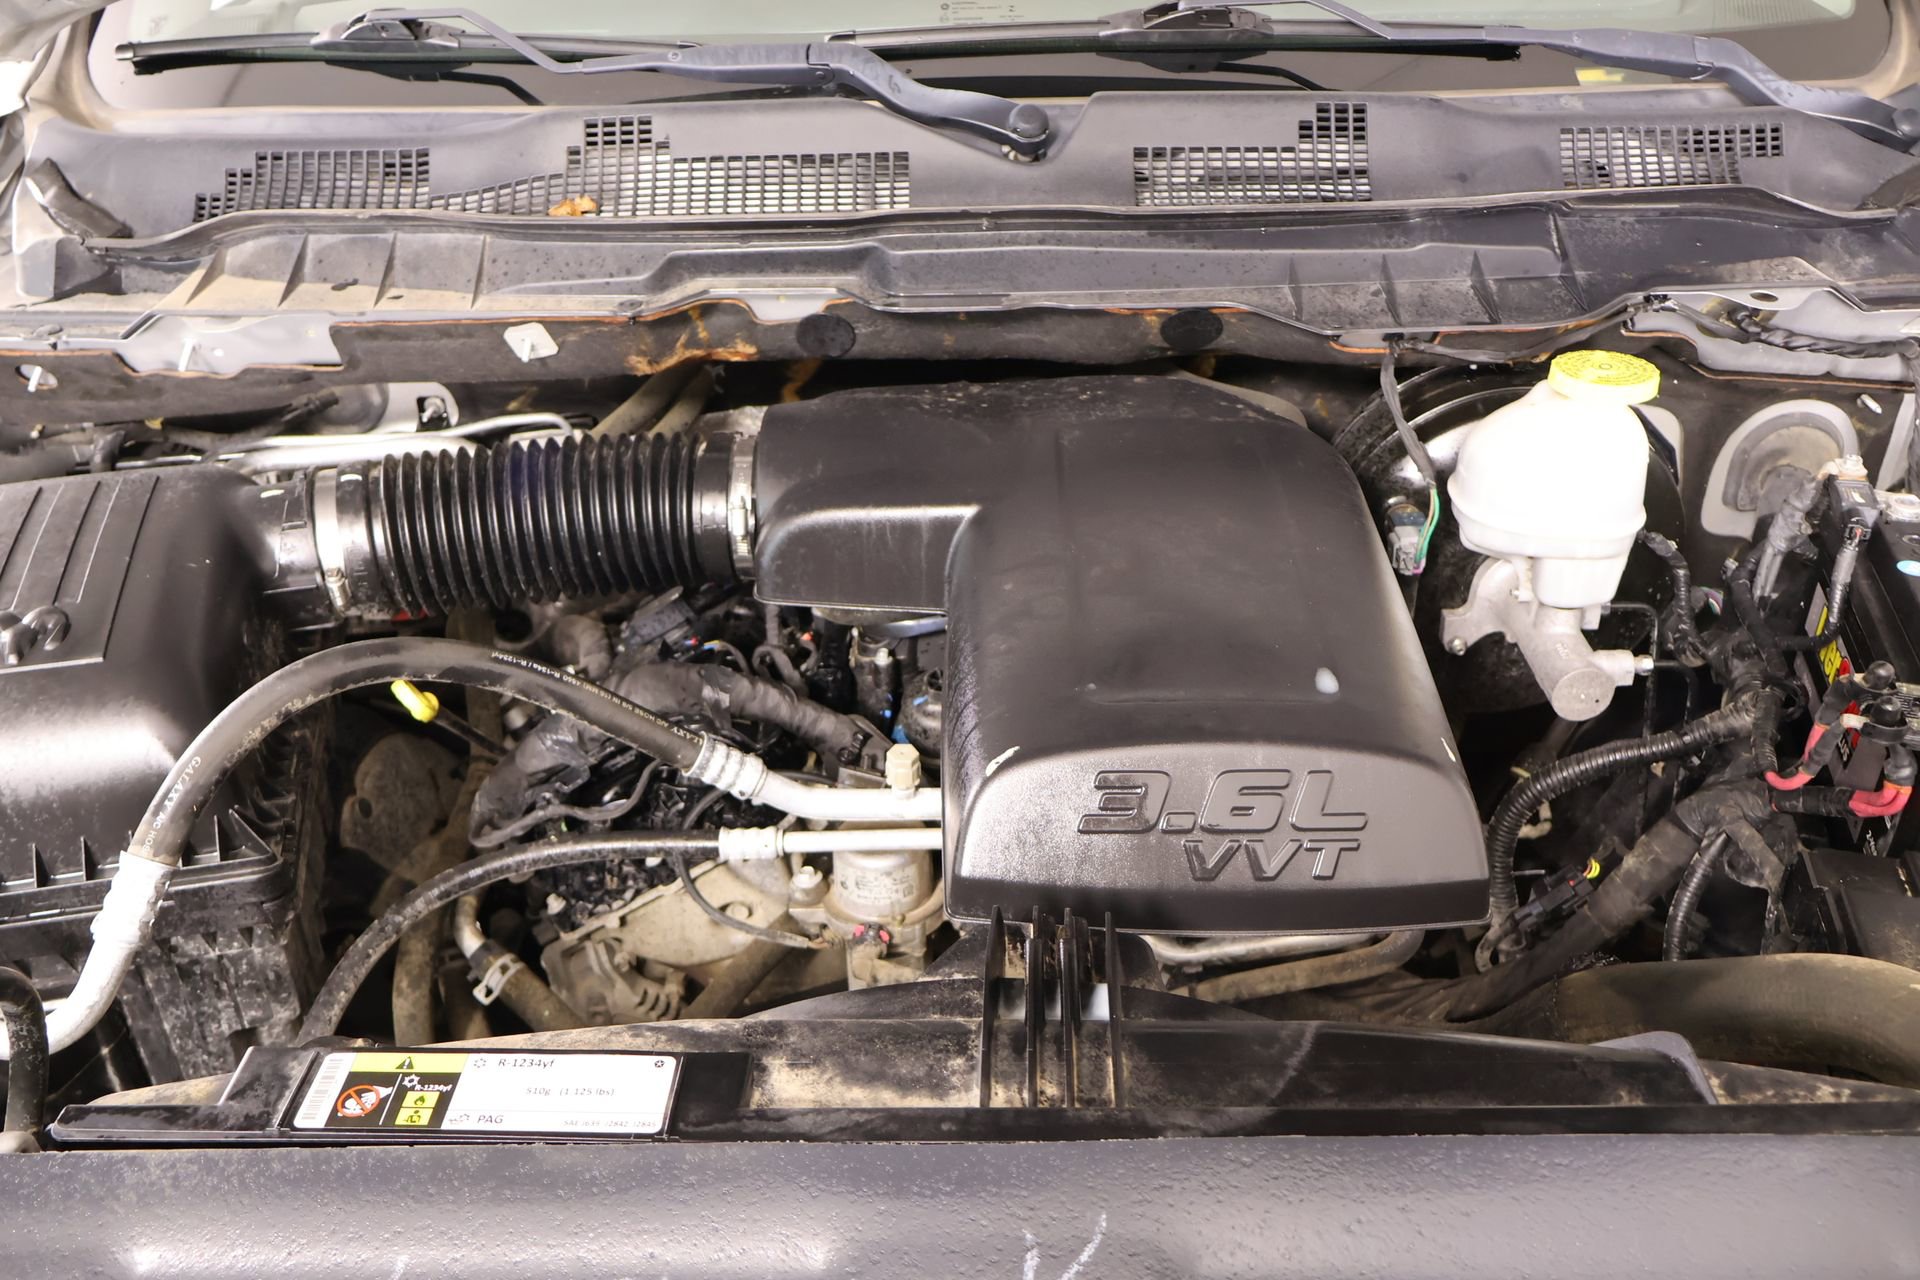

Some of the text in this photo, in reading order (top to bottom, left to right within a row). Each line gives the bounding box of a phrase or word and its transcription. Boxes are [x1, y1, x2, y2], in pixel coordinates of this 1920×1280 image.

[533, 663, 561, 679] R-134a
[633, 707, 655, 721] HOSE
[163, 756, 201, 811] GALAXY
[1077, 769, 1369, 834] 3.6L
[1182, 838, 1361, 881] VVT
[498, 1058, 554, 1069] R-1234yf
[414, 1084, 453, 1093] R-1234yf
[477, 1114, 504, 1125] PAG
